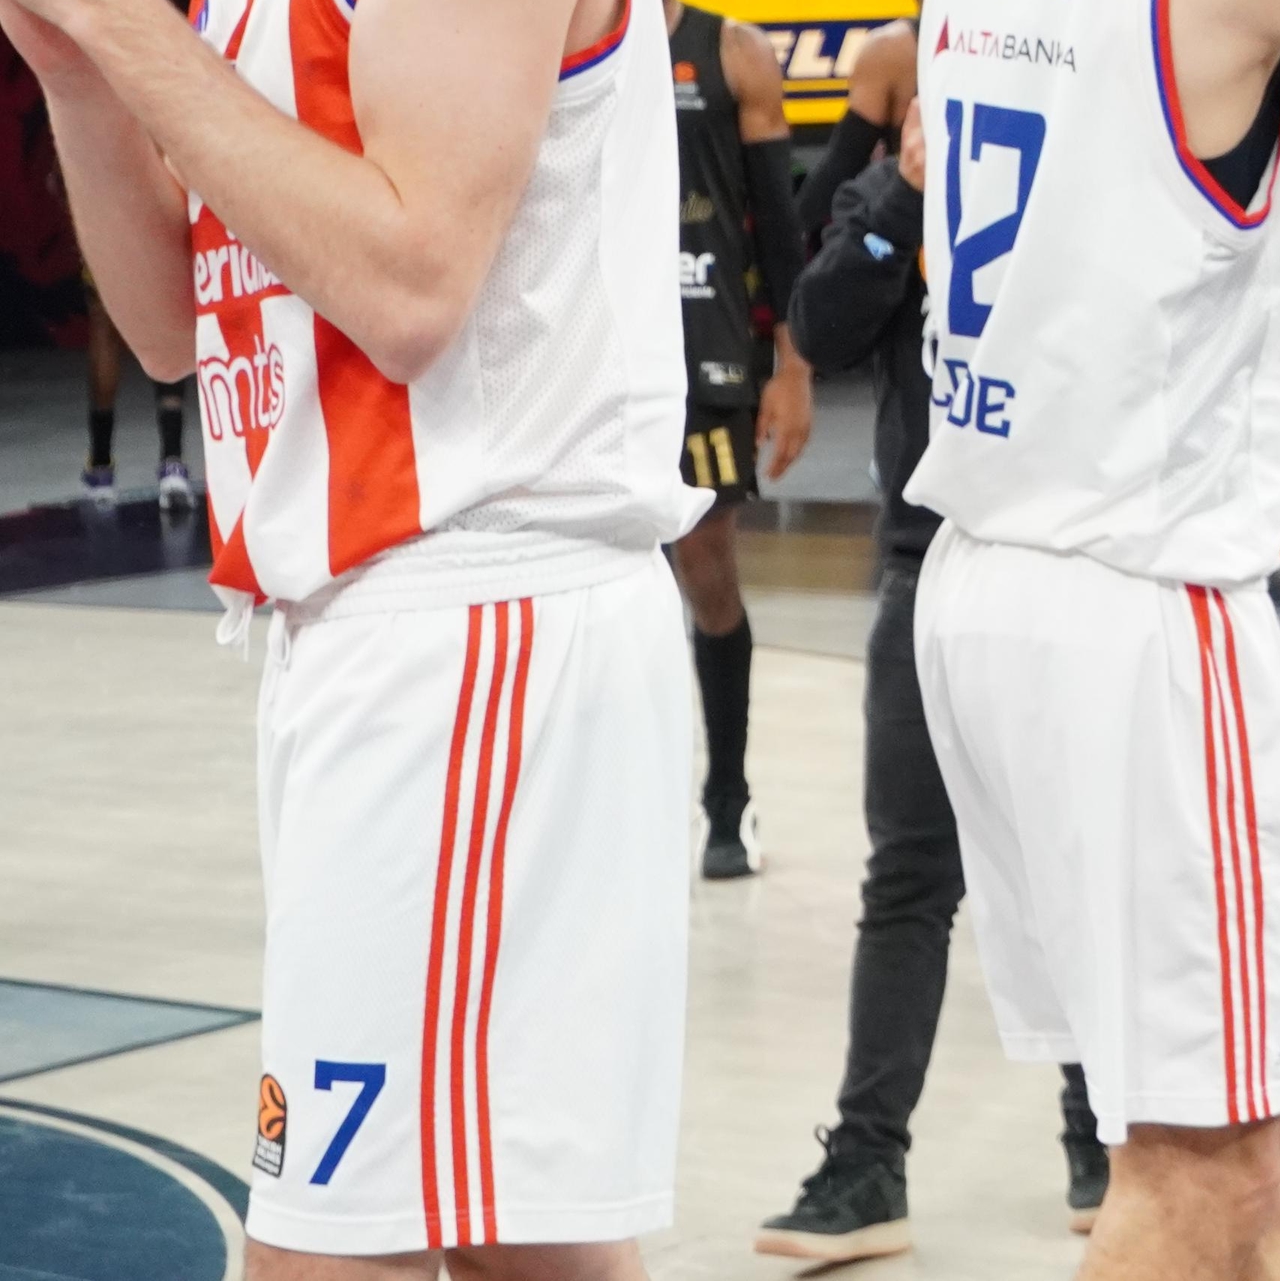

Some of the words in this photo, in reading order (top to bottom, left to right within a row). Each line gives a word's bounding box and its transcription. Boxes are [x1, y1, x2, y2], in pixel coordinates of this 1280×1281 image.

[945, 97, 1047, 338] 12
[199, 333, 287, 442] mts
[686, 426, 738, 487] 11
[309, 1059, 387, 1186] 7
